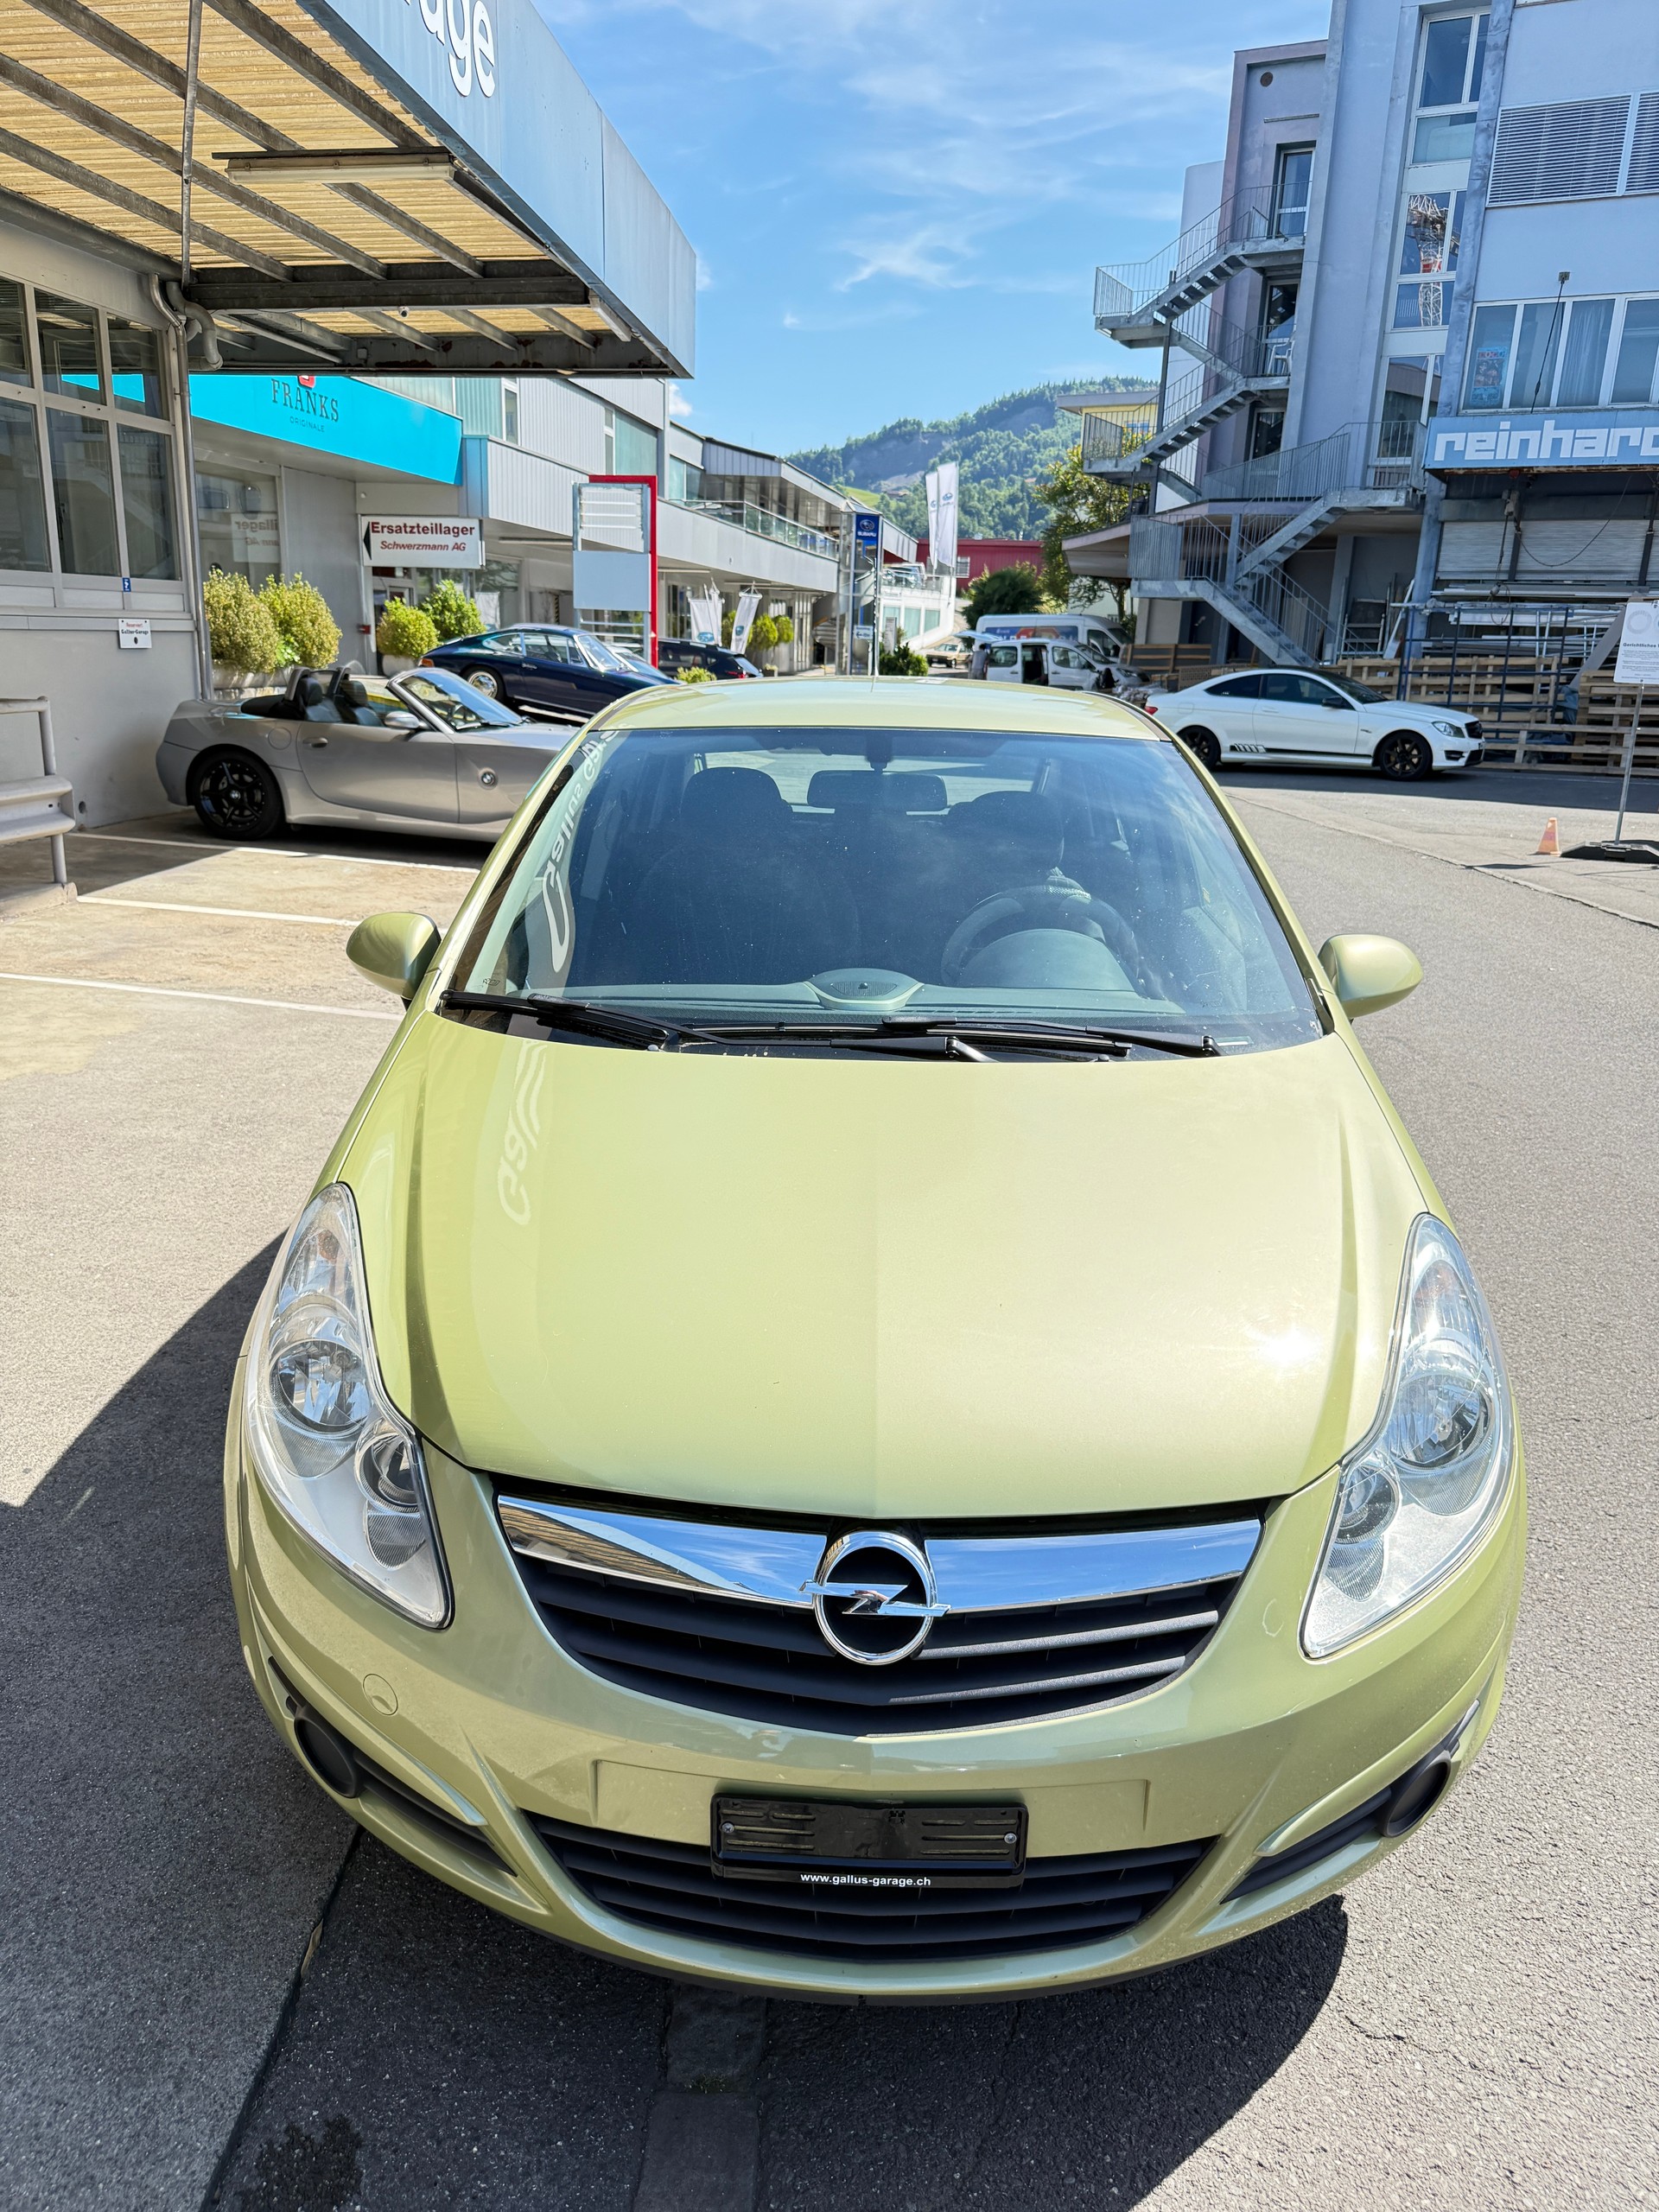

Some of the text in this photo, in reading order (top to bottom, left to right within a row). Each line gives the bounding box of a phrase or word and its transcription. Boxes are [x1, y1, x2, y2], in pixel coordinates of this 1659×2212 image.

[270, 378, 340, 423] FRANKS
[289, 416, 326, 433] ORIGINALE
[371, 521, 475, 537] Ersatzteillager
[380, 541, 467, 551] Schwerzmann AG
[800, 1873, 931, 1887] www.gallus-garage.ch
